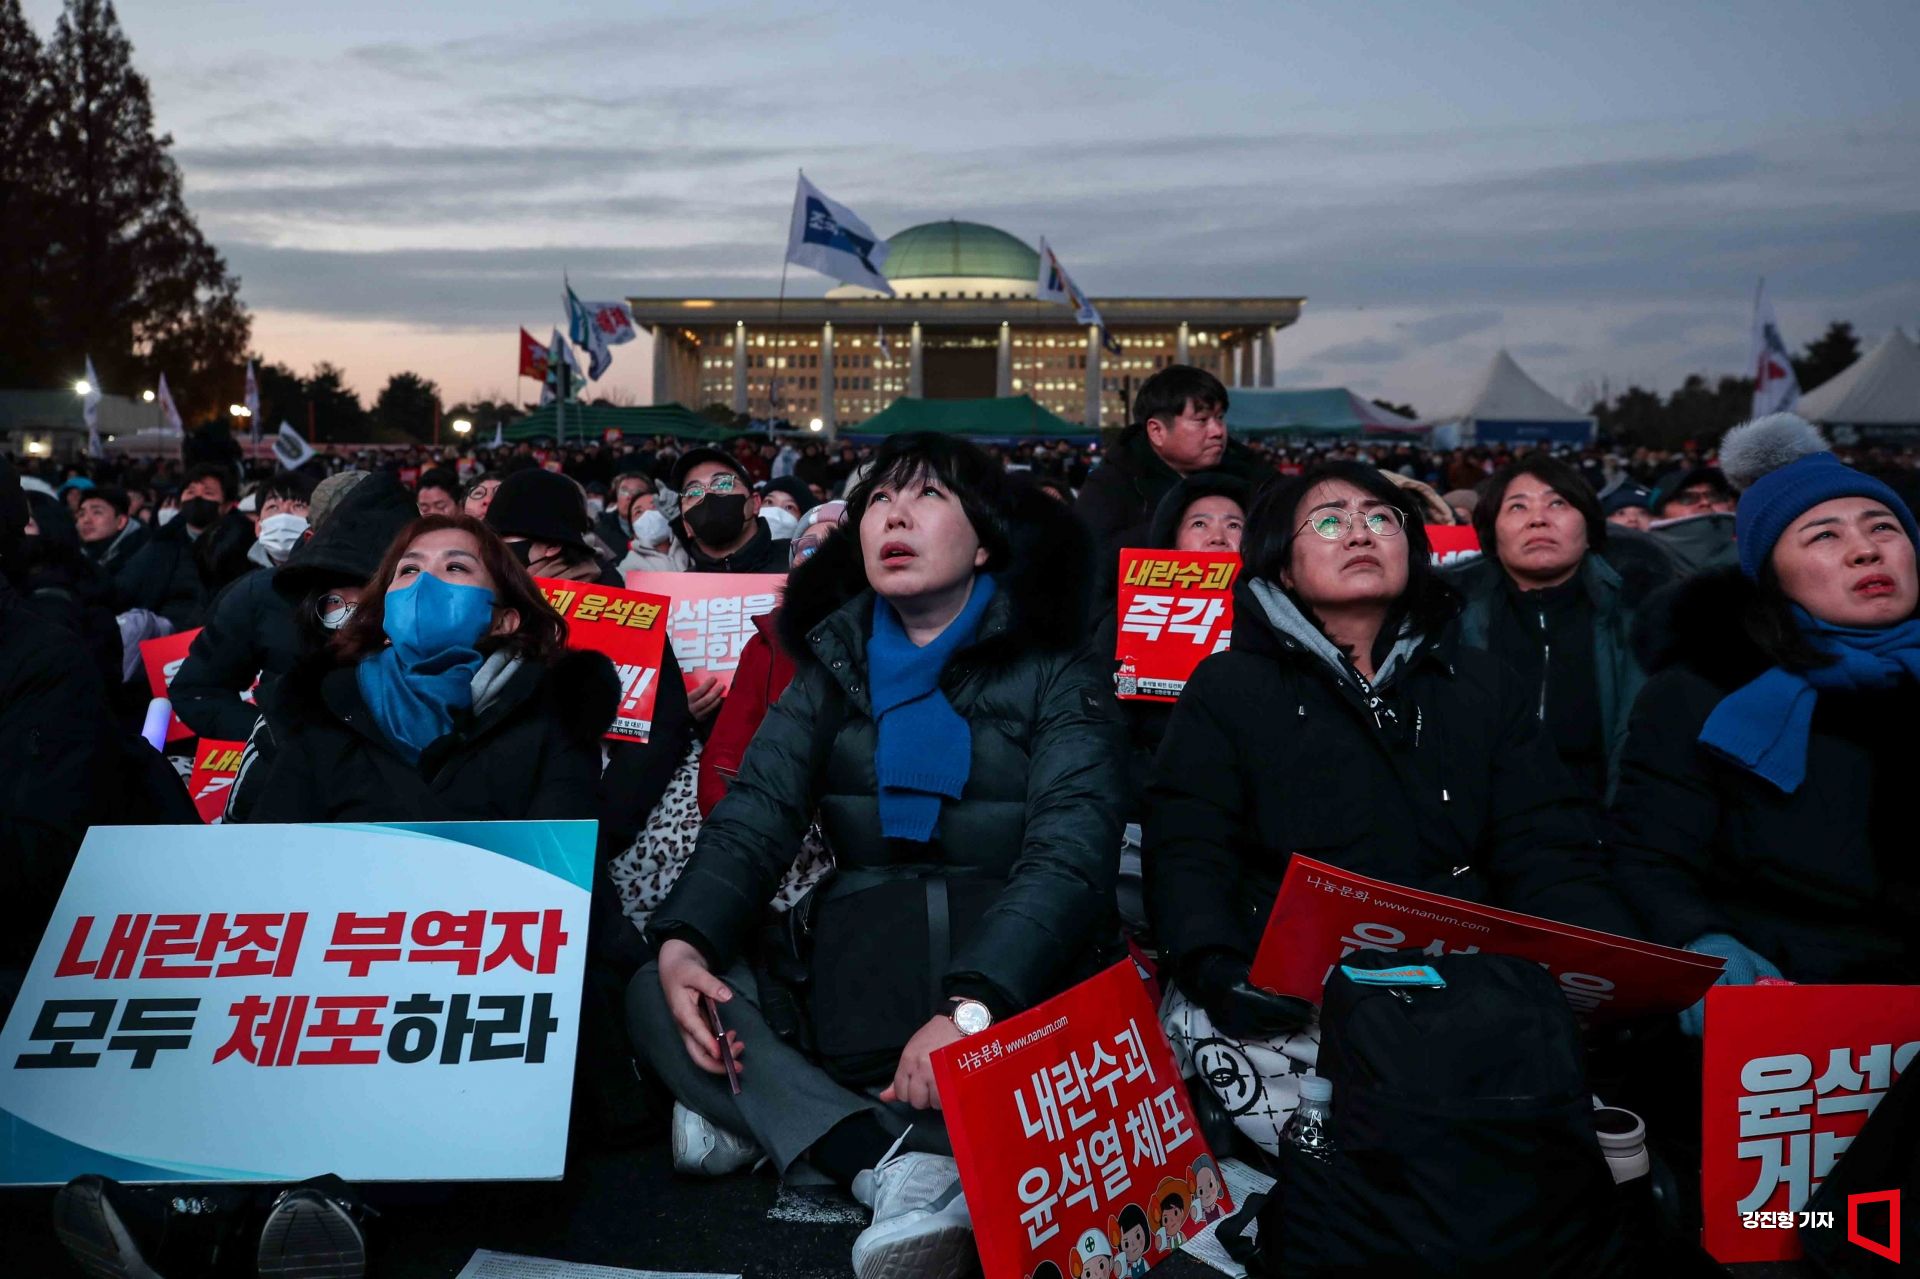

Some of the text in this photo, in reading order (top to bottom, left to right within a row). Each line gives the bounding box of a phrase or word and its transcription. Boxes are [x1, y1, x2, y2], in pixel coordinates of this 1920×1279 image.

[1124, 559, 1236, 590] 내란수괴
[573, 594, 662, 630] 윤석열
[667, 593, 776, 634] 석열을
[1121, 594, 1225, 645] 즉각
[1306, 874, 1491, 934] 나눔문화 www.nanum.com
[54, 908, 568, 980] 내란죄 부역자
[14, 992, 558, 1070] 모두 체포하라
[957, 1013, 1070, 1073] 나눔문화 www.nanum.com
[1013, 1017, 1156, 1143] 내란수괴
[1737, 1040, 1920, 1139] 윤석
[1016, 1117, 1133, 1251] 윤석열
[1124, 1086, 1194, 1168] 체포
